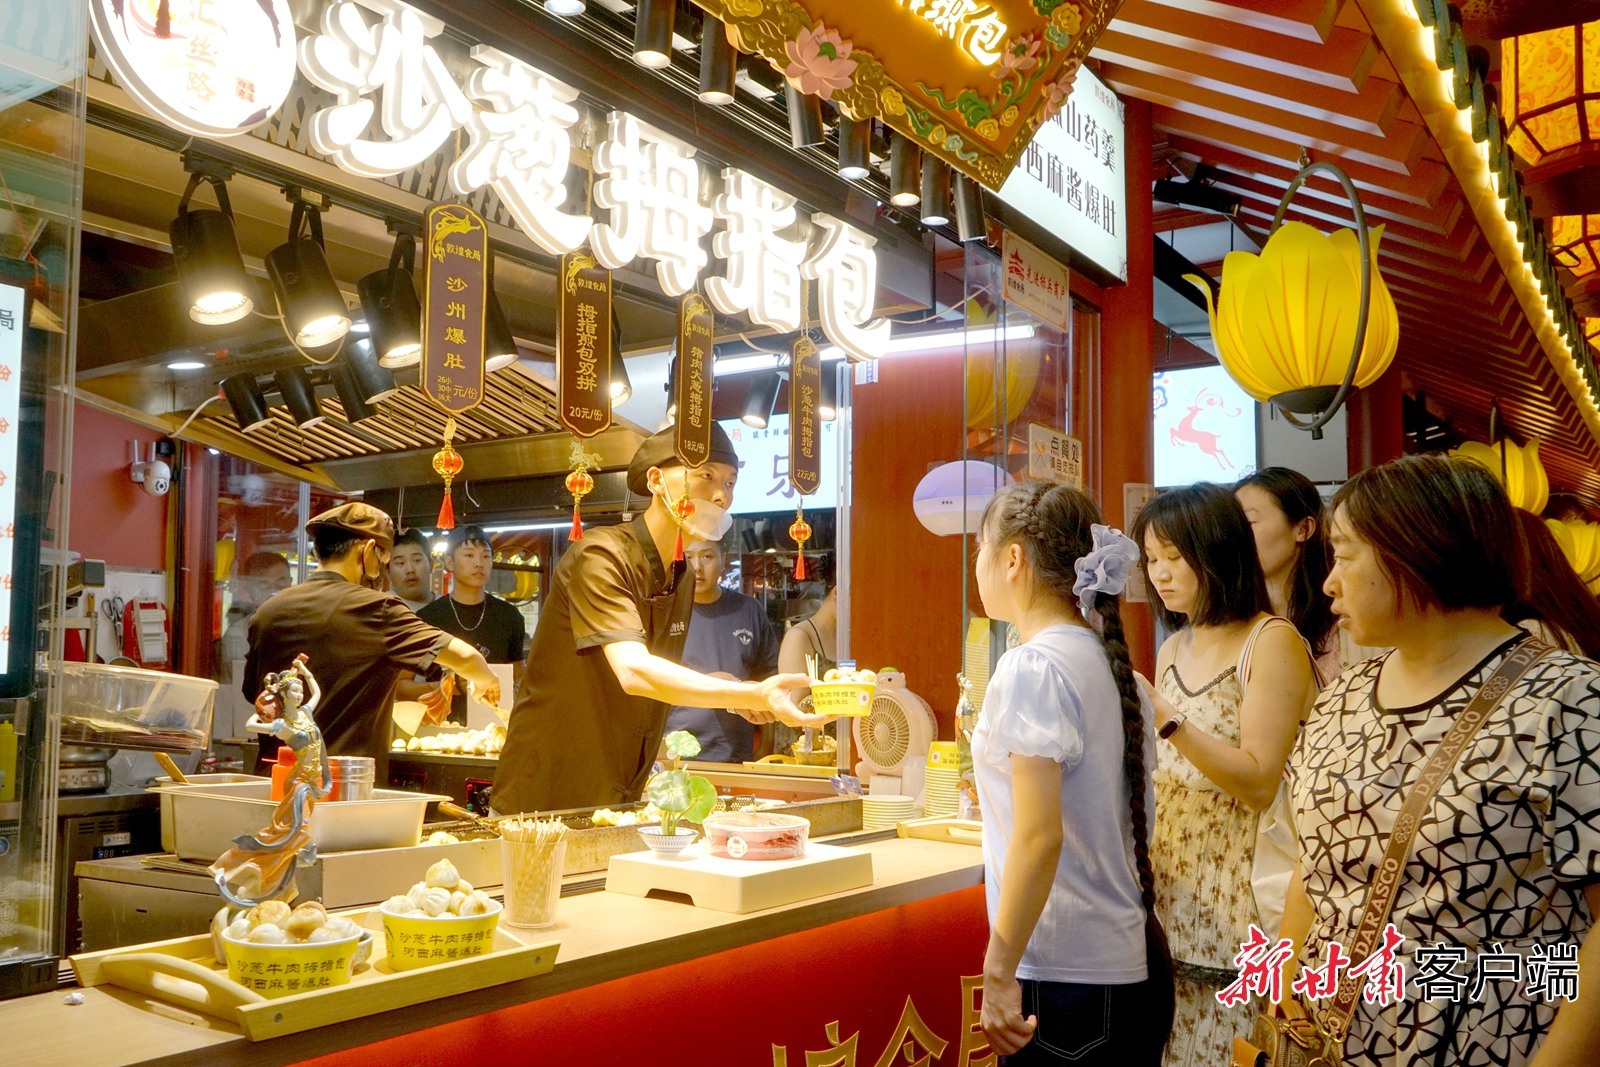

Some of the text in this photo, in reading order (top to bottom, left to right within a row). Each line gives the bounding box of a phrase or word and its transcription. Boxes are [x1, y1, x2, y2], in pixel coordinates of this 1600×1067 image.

[299, 1, 891, 362] 沙葱拇指包
[1016, 140, 1118, 238] 西麻酱爆肚
[443, 276, 468, 370] 沙州爆肚
[576, 302, 598, 392] 拇指煎包双拼
[569, 406, 603, 422] 20元/份
[1415, 710, 1482, 798] DARASCO
[1353, 857, 1400, 958] DARASCO
